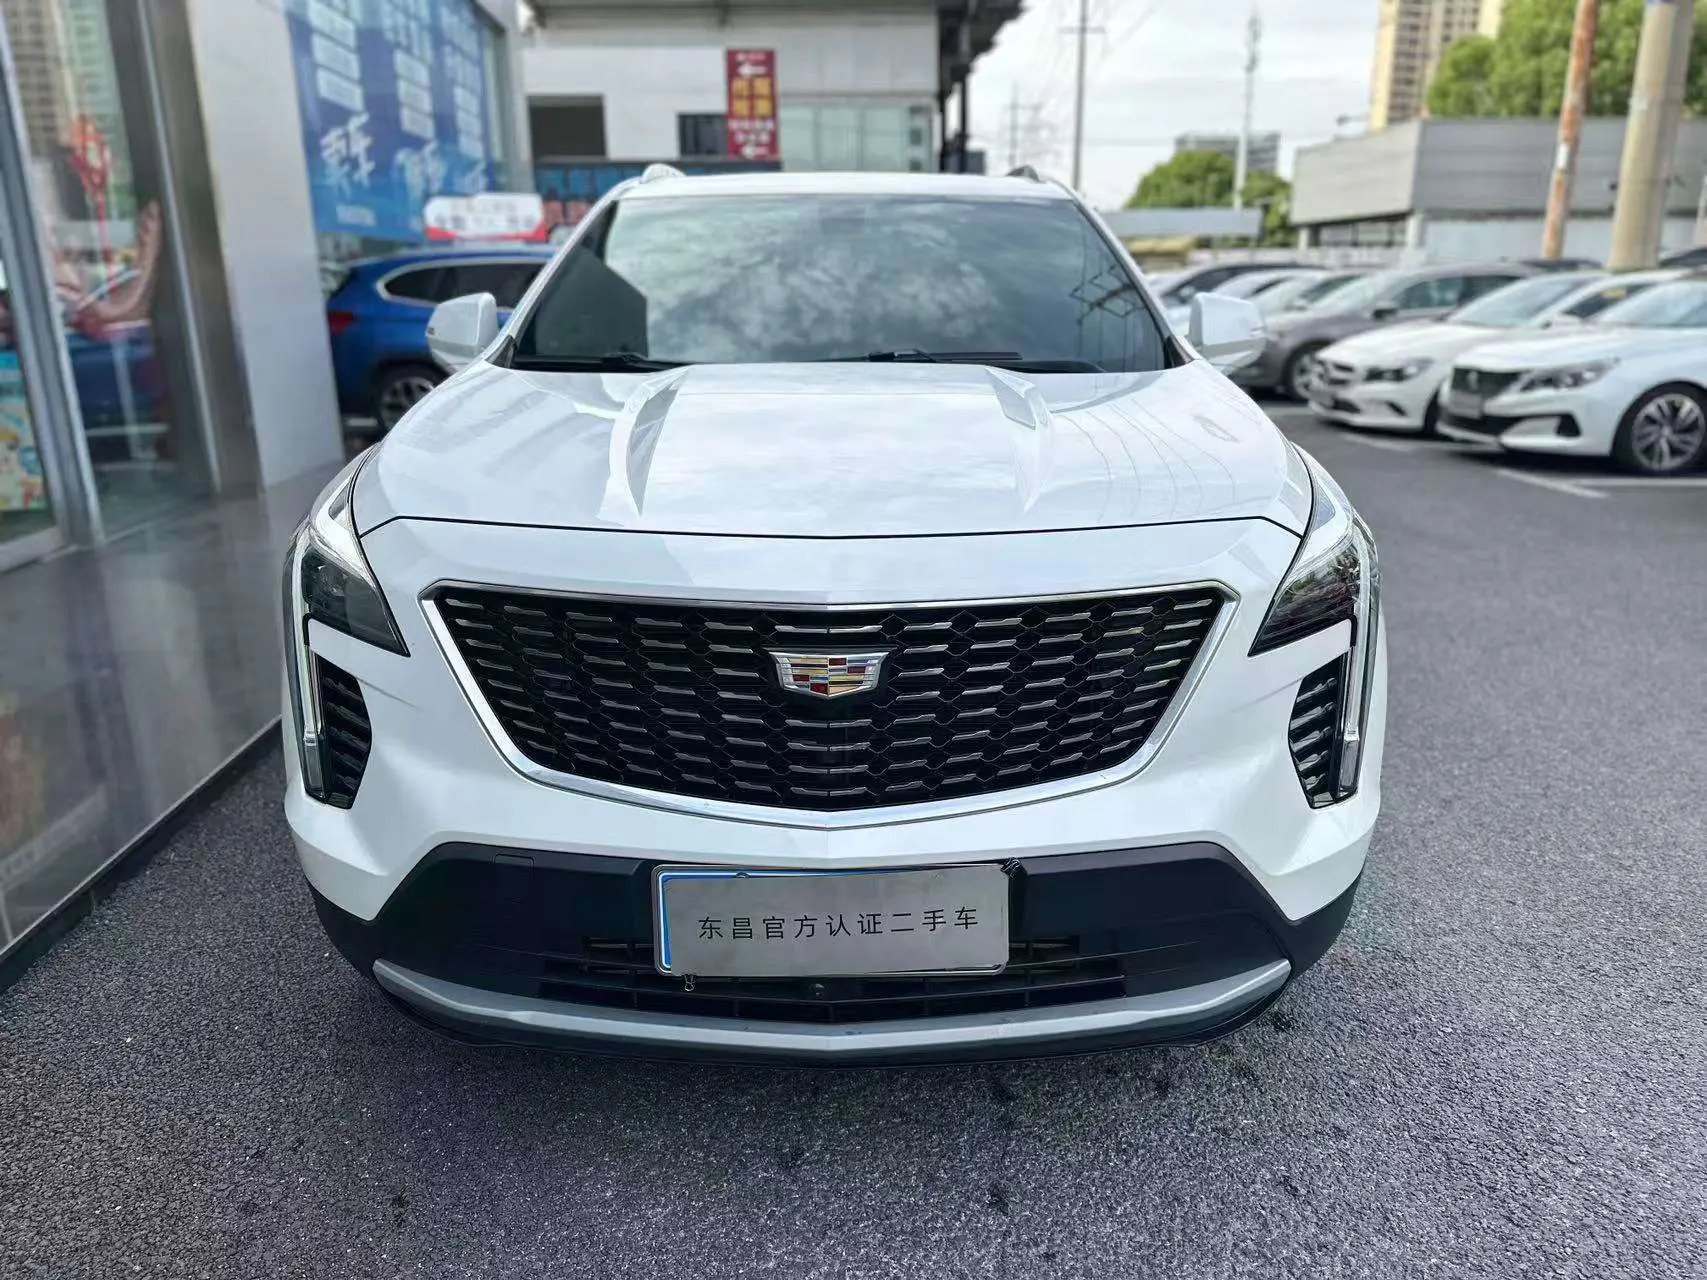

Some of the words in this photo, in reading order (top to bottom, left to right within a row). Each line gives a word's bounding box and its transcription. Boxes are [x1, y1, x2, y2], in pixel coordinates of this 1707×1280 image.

[698, 906, 978, 939] 东昌官方认证二手车
